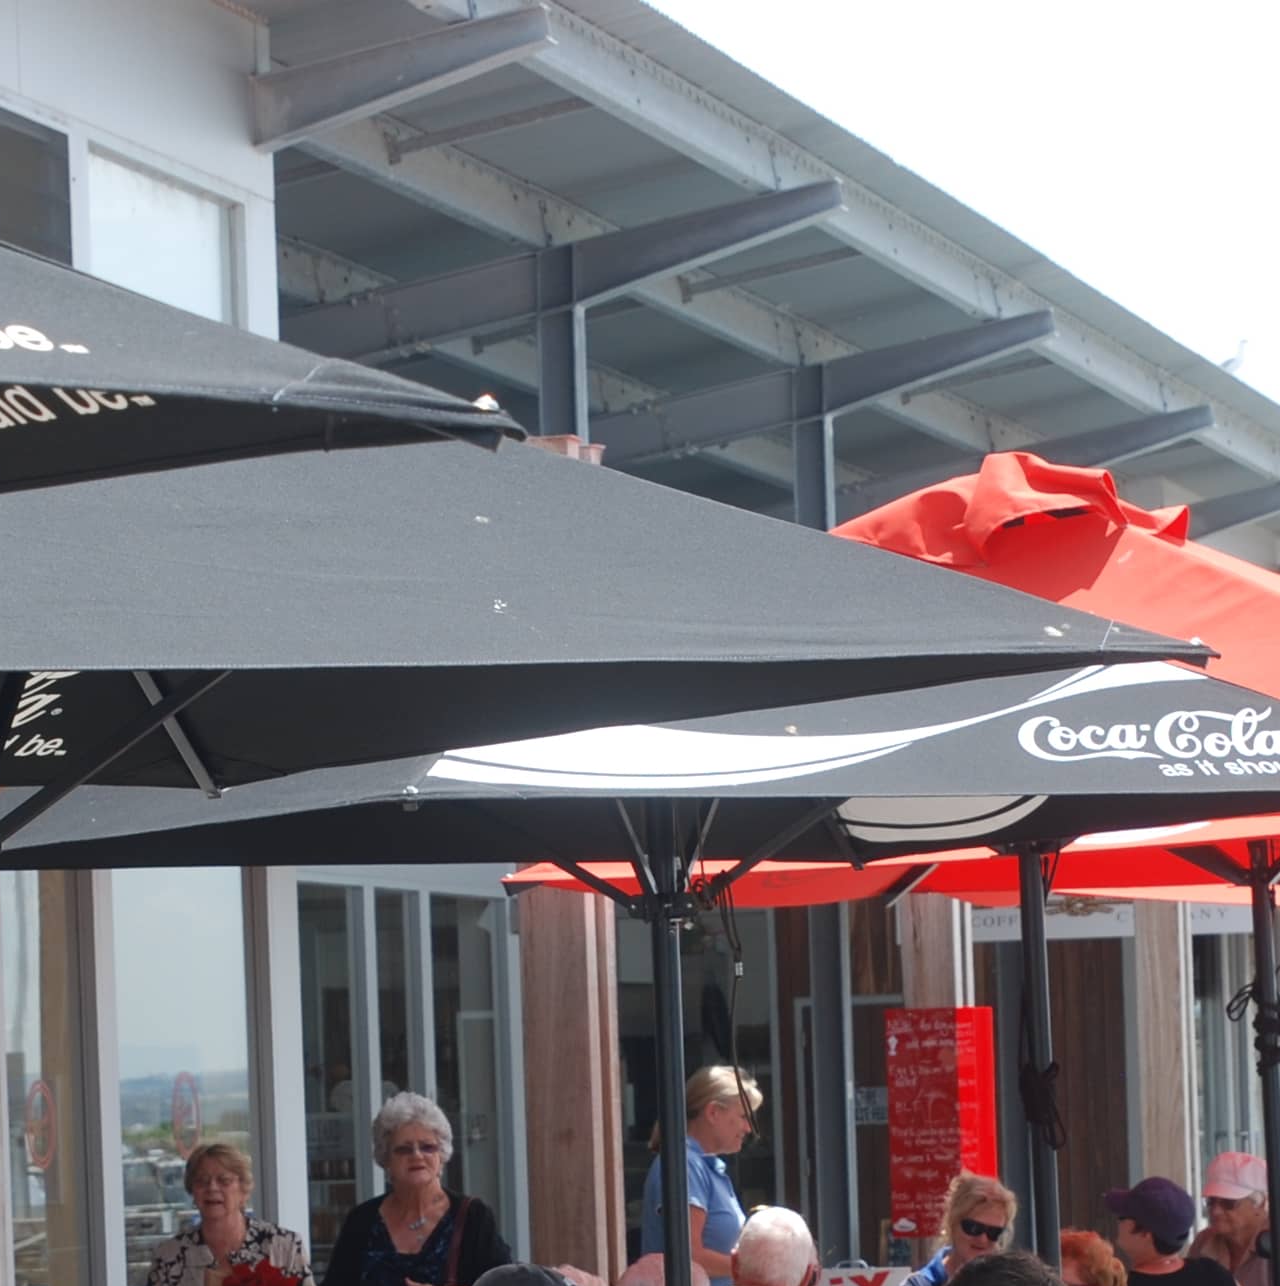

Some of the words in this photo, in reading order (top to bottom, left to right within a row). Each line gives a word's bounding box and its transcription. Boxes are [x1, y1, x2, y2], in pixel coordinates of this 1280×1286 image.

[1158, 763, 1194, 777] as
[1195, 759, 1220, 776] it
[972, 913, 1019, 929] COFF
